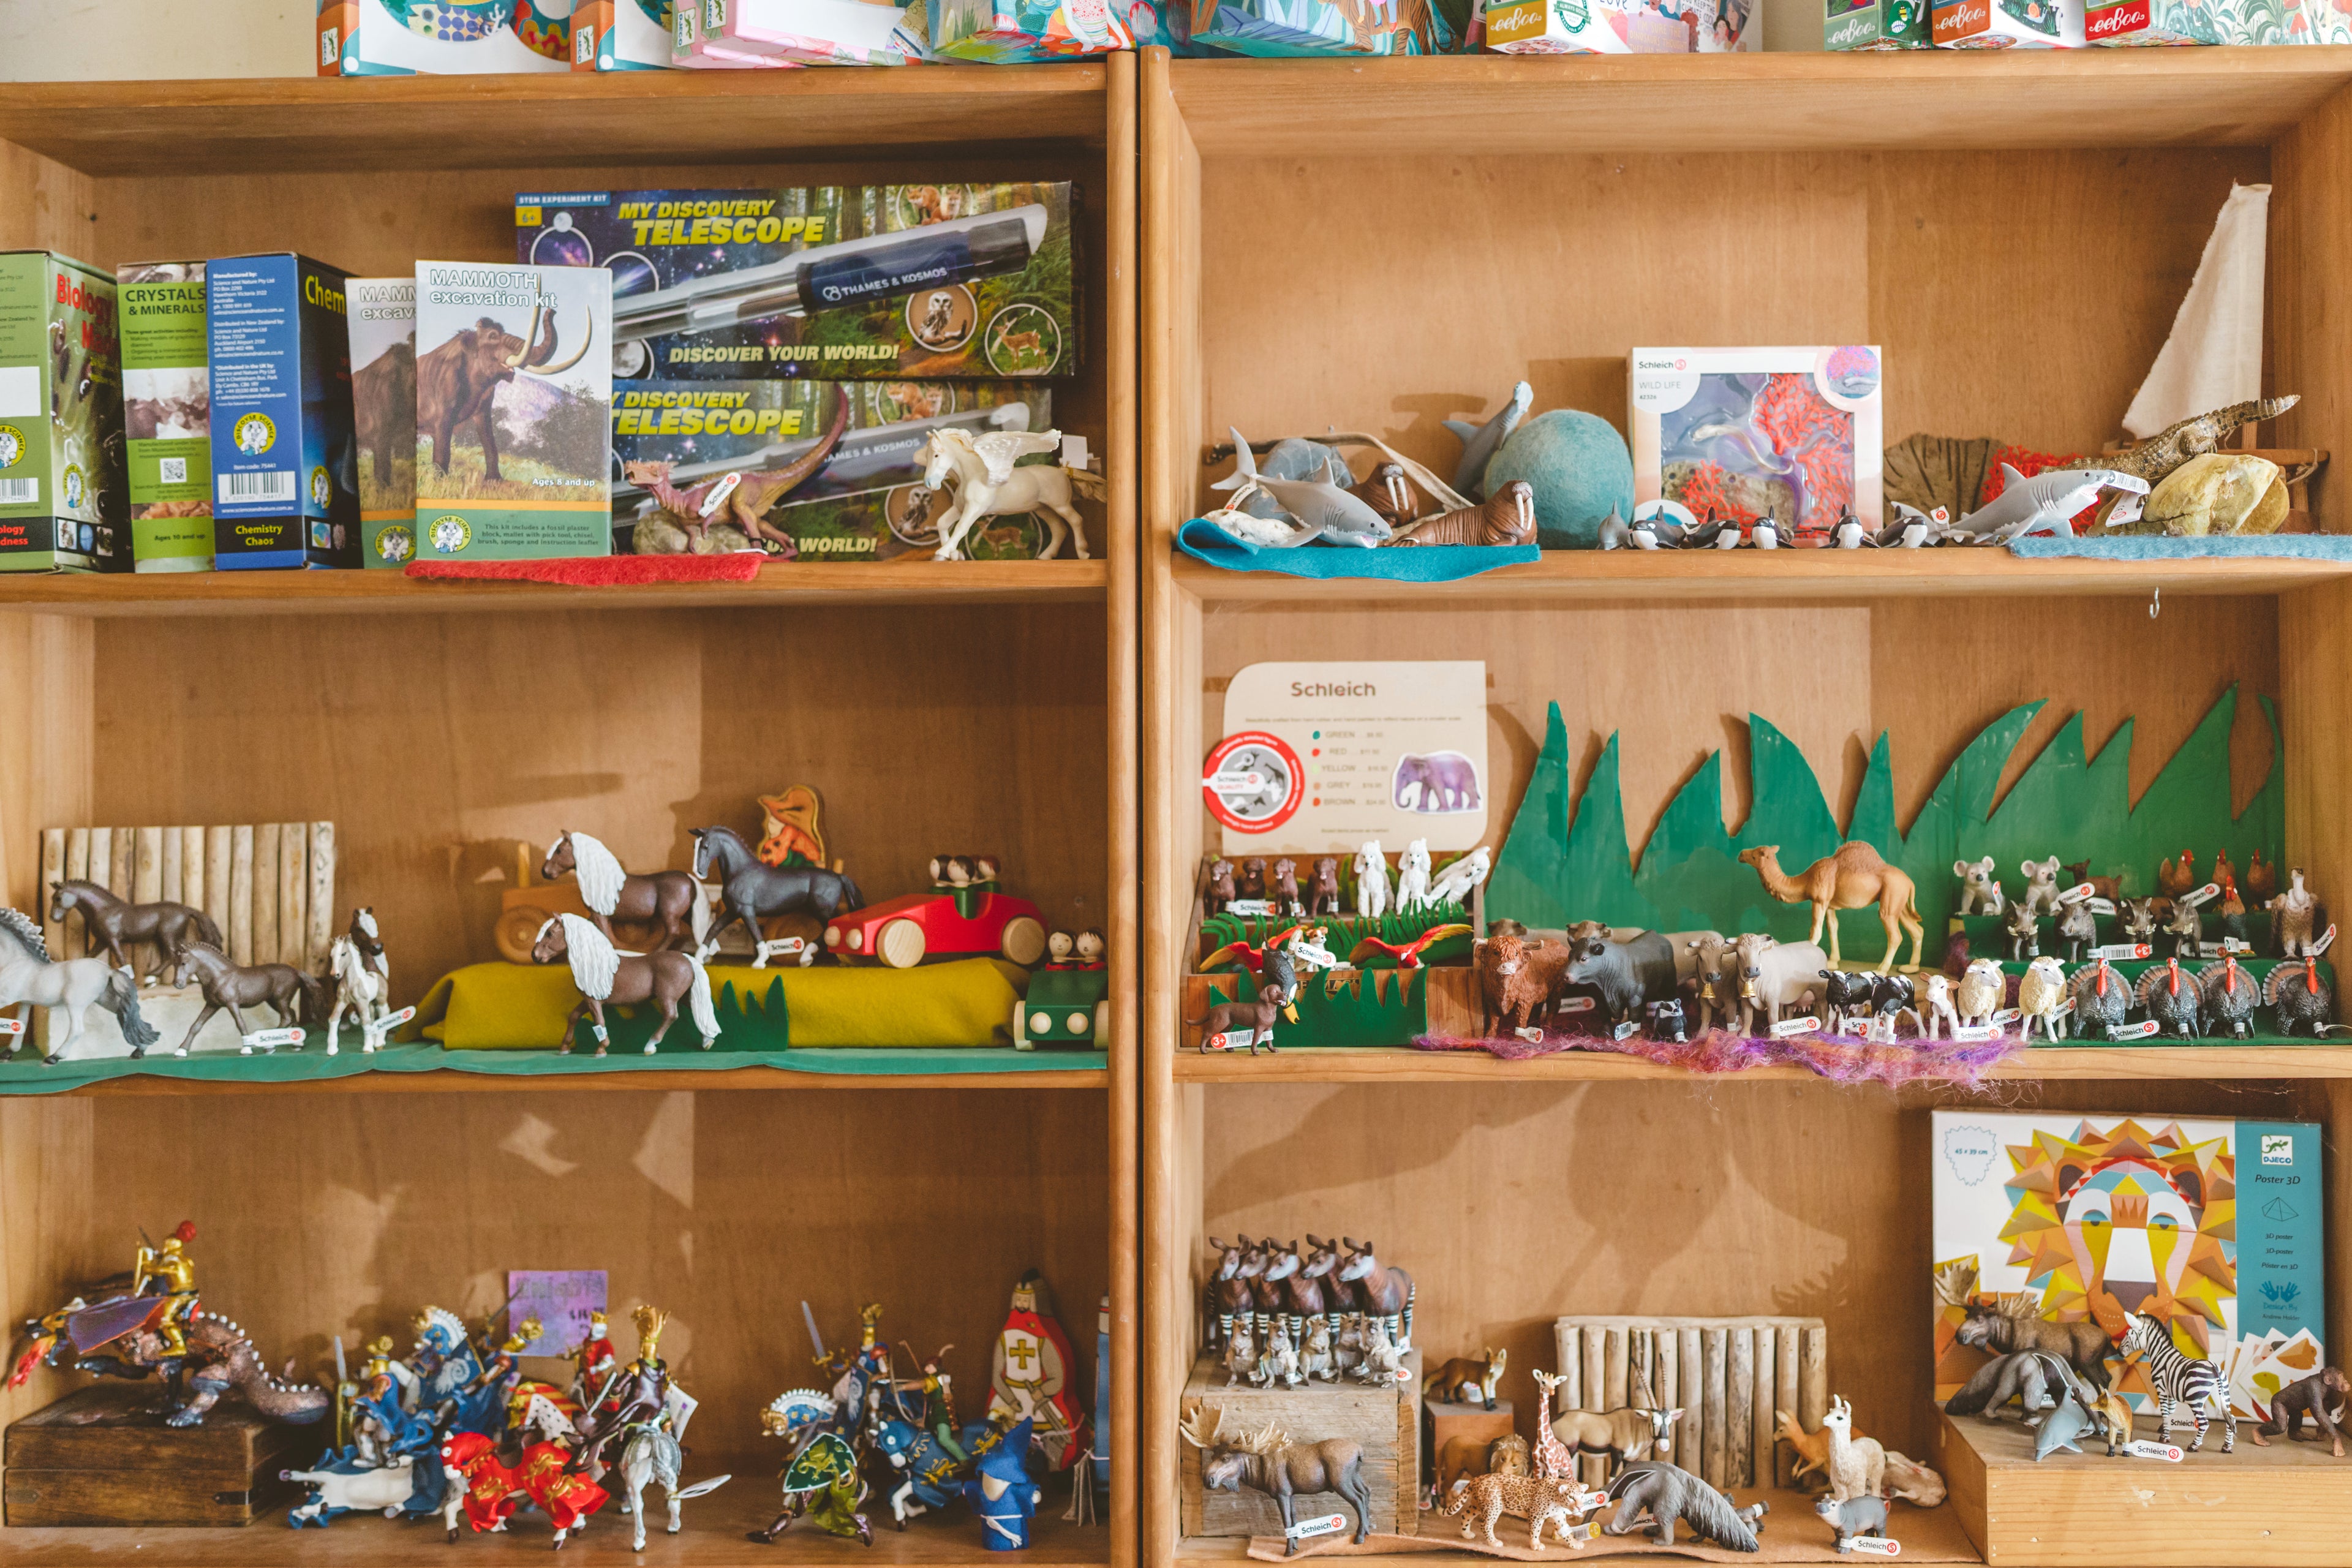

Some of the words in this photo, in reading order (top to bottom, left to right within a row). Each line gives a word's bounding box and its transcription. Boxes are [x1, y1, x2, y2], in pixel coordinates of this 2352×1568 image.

[618, 203, 654, 219] MY
[656, 200, 777, 218] DISCOVERY
[631, 216, 827, 246] TELESCOPE
[430, 270, 538, 290] MAMMOTH
[841, 279, 889, 296] THAMES
[891, 277, 900, 286] &
[901, 267, 948, 284] KOSMOS
[126, 288, 206, 301] CRYSTALS
[430, 290, 530, 307] excavation
[534, 291, 558, 308] kit
[129, 306, 137, 315] &
[141, 304, 205, 315] MINERALS
[361, 307, 416, 320] excav
[669, 347, 764, 363] DISCOVER
[769, 345, 820, 361] YOUR
[824, 344, 900, 361] WORLD!
[624, 391, 750, 408] DISCOVERY
[236, 415, 256, 440] DISCOVER
[259, 416, 274, 439] SCIENCE
[9, 428, 24, 451] SCIENCE
[863, 447, 872, 456] &
[873, 437, 921, 454] KOSMOS
[532, 478, 554, 487] Ages
[564, 478, 581, 486] and
[583, 479, 595, 488] up
[709, 483, 729, 506] Schleich
[235, 524, 284, 535] Chemistry
[431, 517, 452, 538] DISCOVER
[455, 518, 470, 538] SCIENCE
[246, 537, 274, 546] Chaos
[800, 537, 878, 552] WORLD!
[1291, 681, 1377, 697] Schleich
[1298, 946, 1322, 960] Schleich
[377, 1016, 402, 1030] Schleich
[1779, 1022, 1806, 1032] Schleich
[1961, 1031, 1988, 1039] Schleich
[2116, 1025, 2144, 1037] Schleich
[260, 1034, 289, 1042] Schleich
[1213, 1036, 1225, 1046] 3+
[2255, 1174, 2284, 1183] Poster
[2286, 1176, 2301, 1185] 3D
[2171, 1419, 2194, 1428] Schleich
[2138, 1446, 2167, 1456] Schleich
[1301, 1521, 1332, 1534] Schleich
[1858, 1540, 1887, 1550] Schleich
